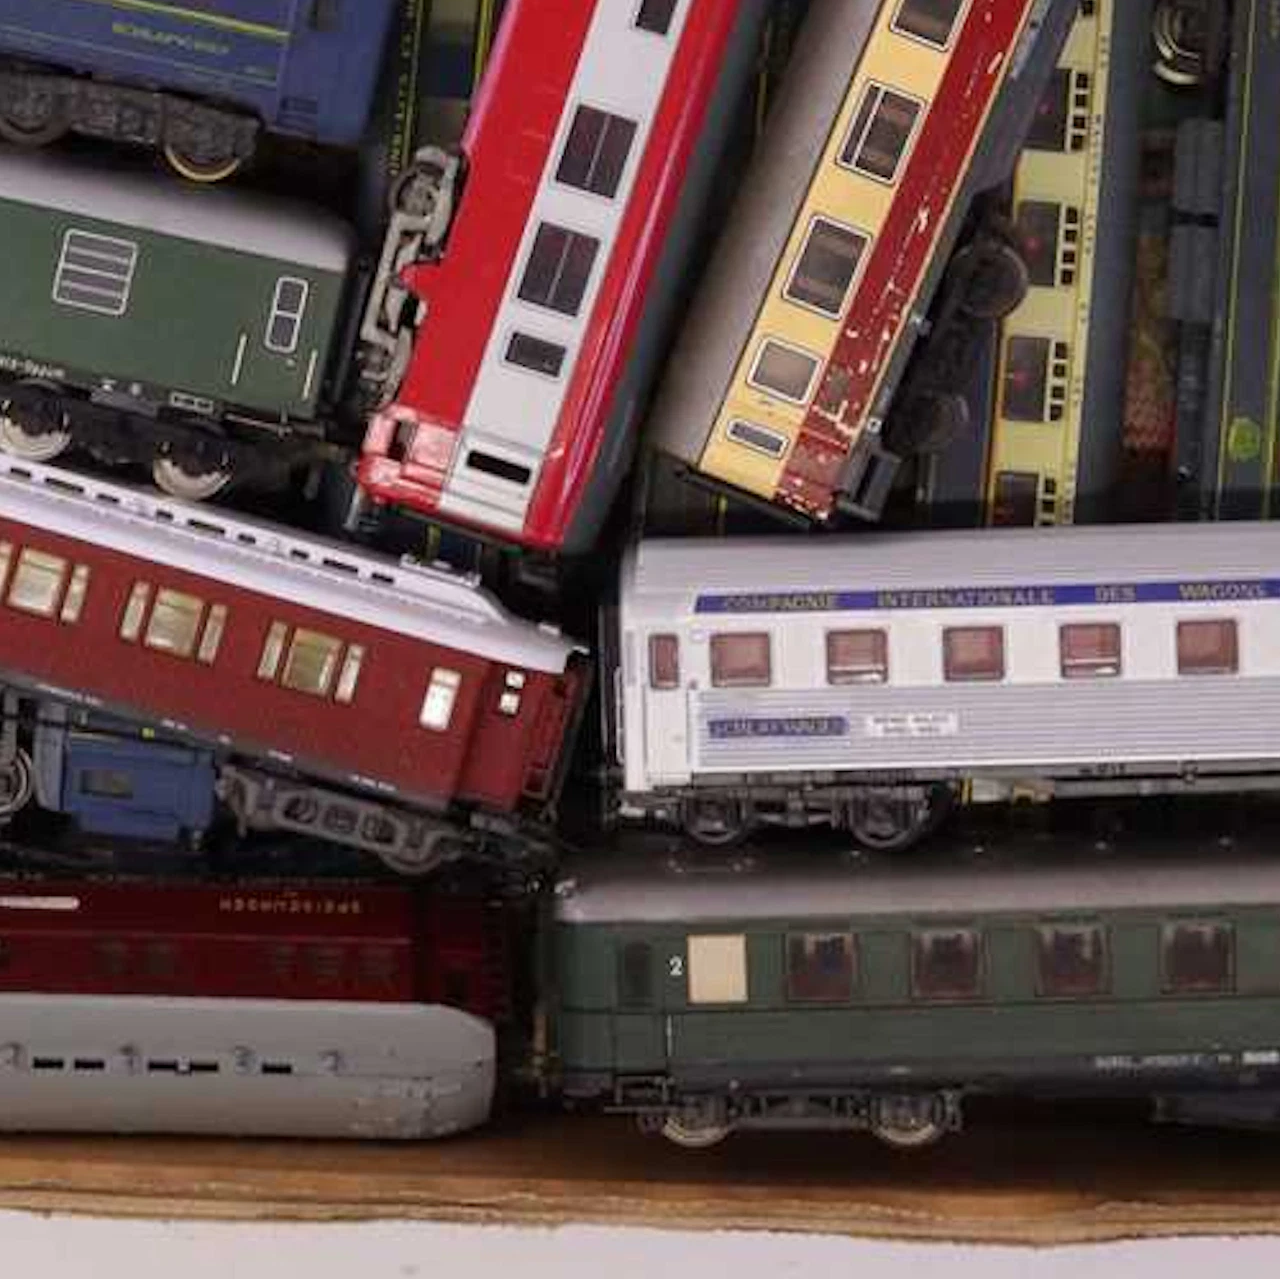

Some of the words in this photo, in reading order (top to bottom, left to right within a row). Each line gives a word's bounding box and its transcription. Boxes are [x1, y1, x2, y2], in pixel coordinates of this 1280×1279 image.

[721, 592, 837, 610] COMPAGNIE
[878, 587, 1054, 608] INTERNATIONALE
[1094, 585, 1138, 602] DES
[1179, 581, 1265, 600] WAGONS
[669, 955, 682, 976] 2
